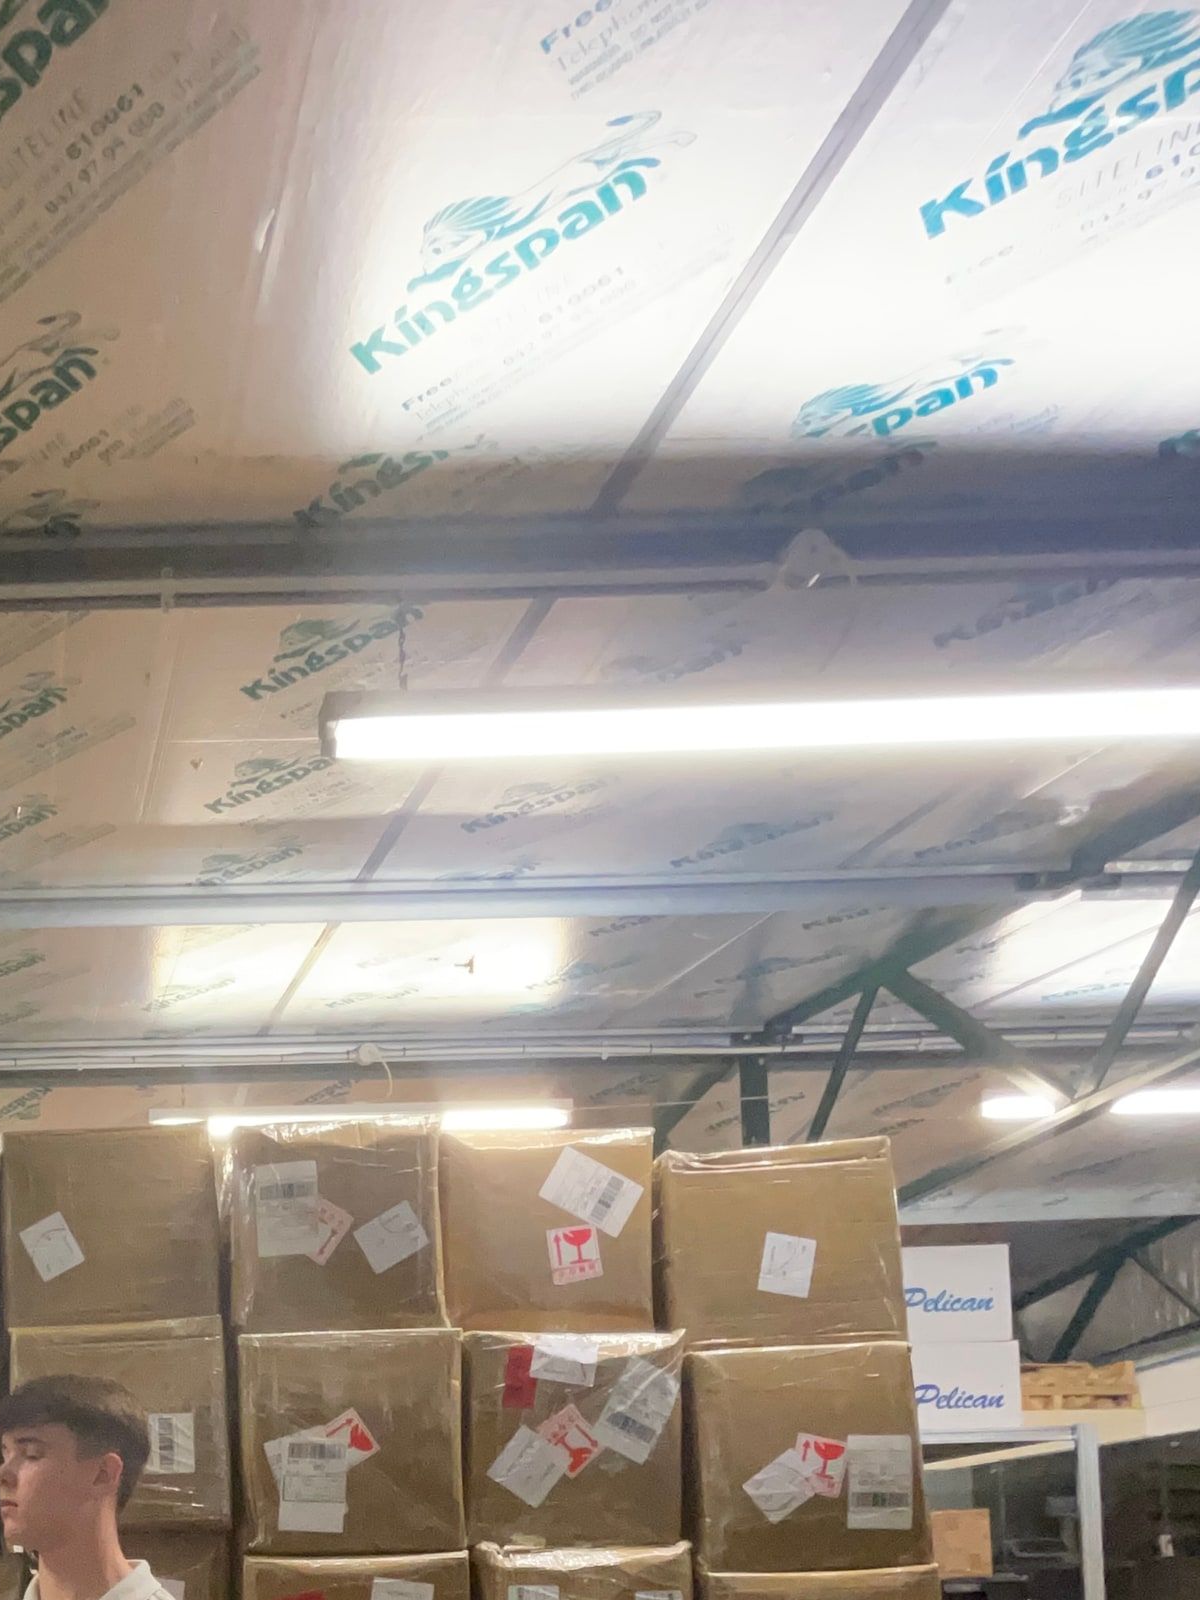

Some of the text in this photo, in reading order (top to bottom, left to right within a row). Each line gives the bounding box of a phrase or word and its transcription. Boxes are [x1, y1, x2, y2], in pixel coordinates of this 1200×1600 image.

[349, 171, 647, 375] Kingspan
[239, 606, 424, 700] Kingspan
[204, 756, 335, 814] Kingspa
[904, 1287, 994, 1313] Pelican
[914, 1384, 1004, 1410] Pelican
